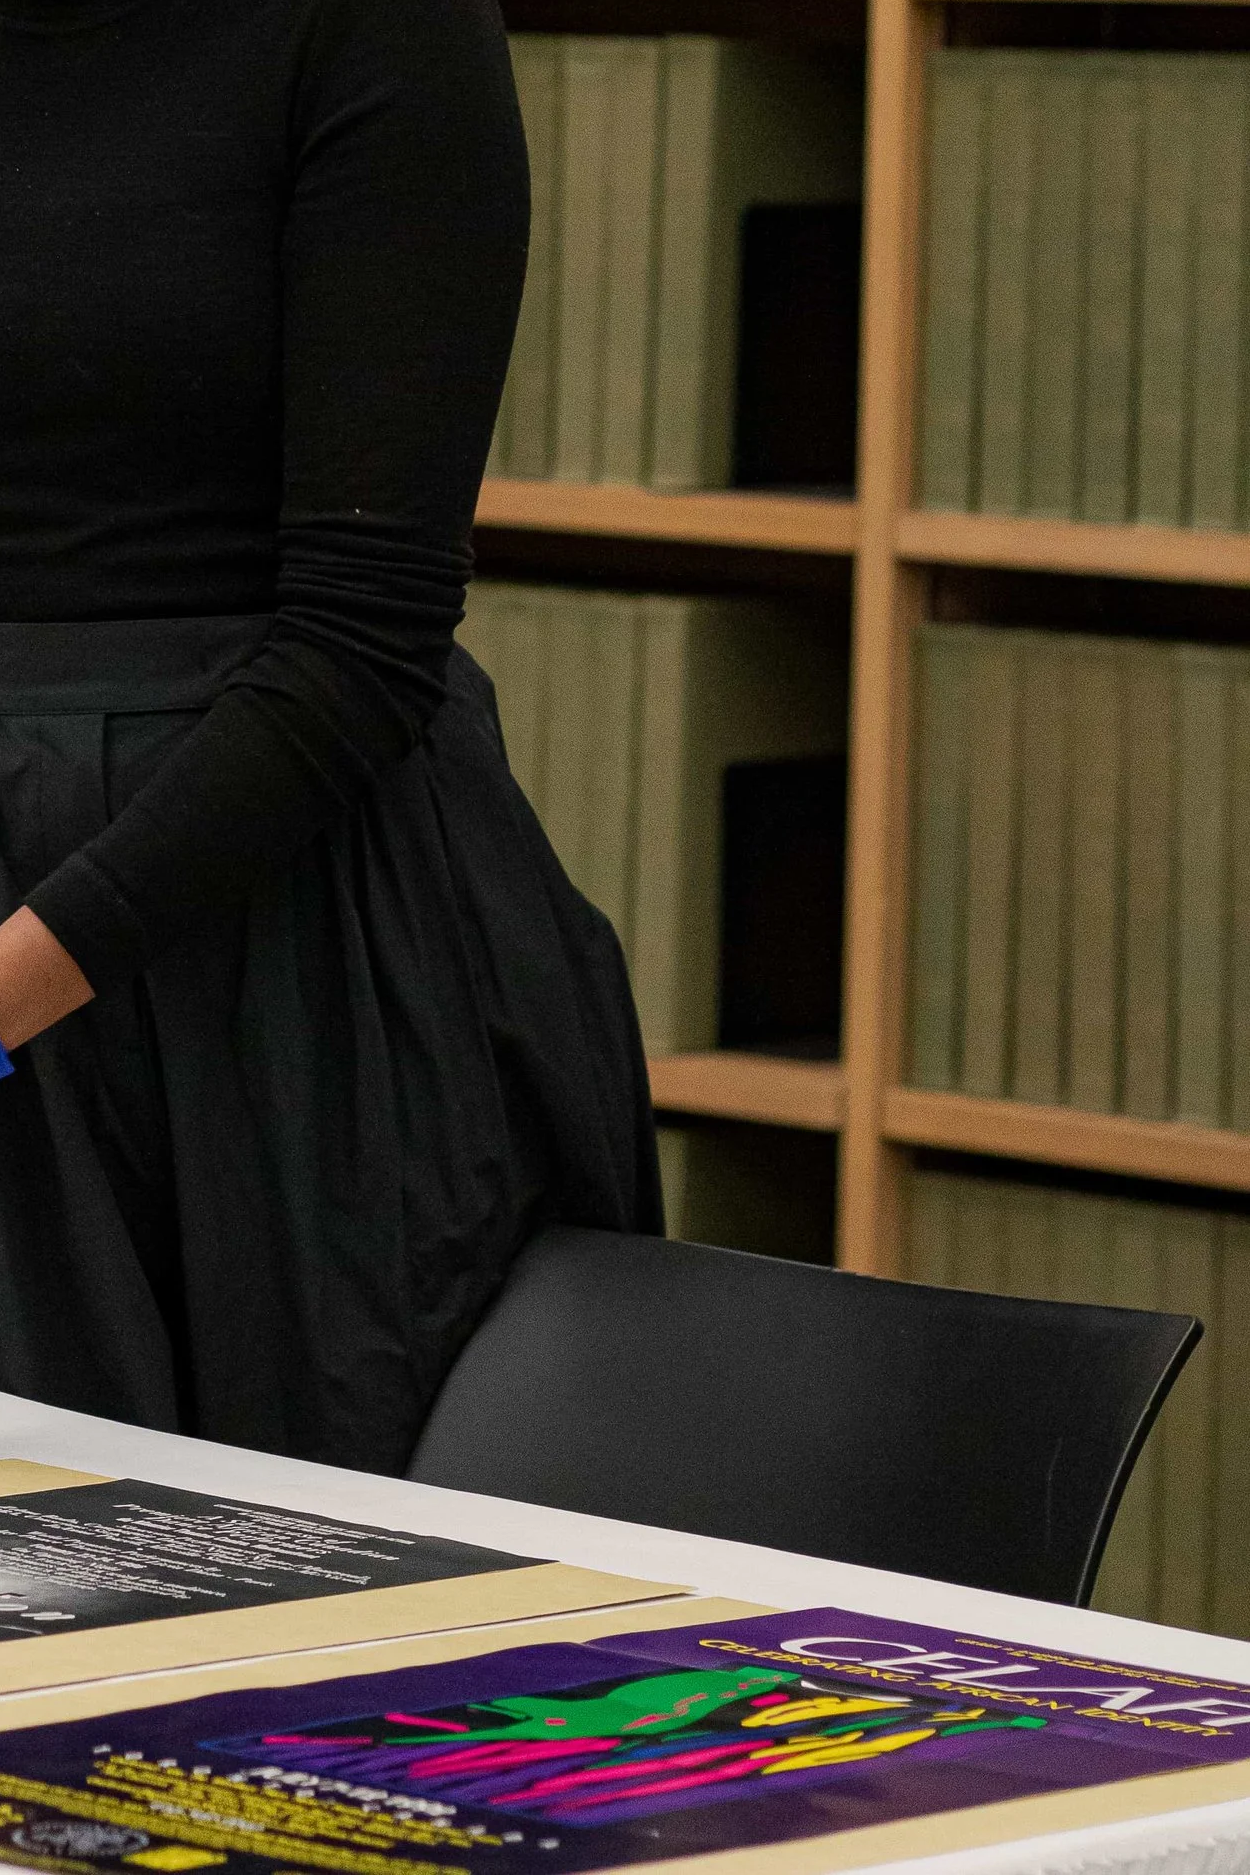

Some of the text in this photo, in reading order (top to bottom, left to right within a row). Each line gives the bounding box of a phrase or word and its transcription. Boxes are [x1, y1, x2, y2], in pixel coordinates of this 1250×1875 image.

[698, 1637, 917, 1684] CELEBRATING
[916, 1676, 1075, 1711] AFRICAN
[1074, 1707, 1235, 1737] IDENTITY
